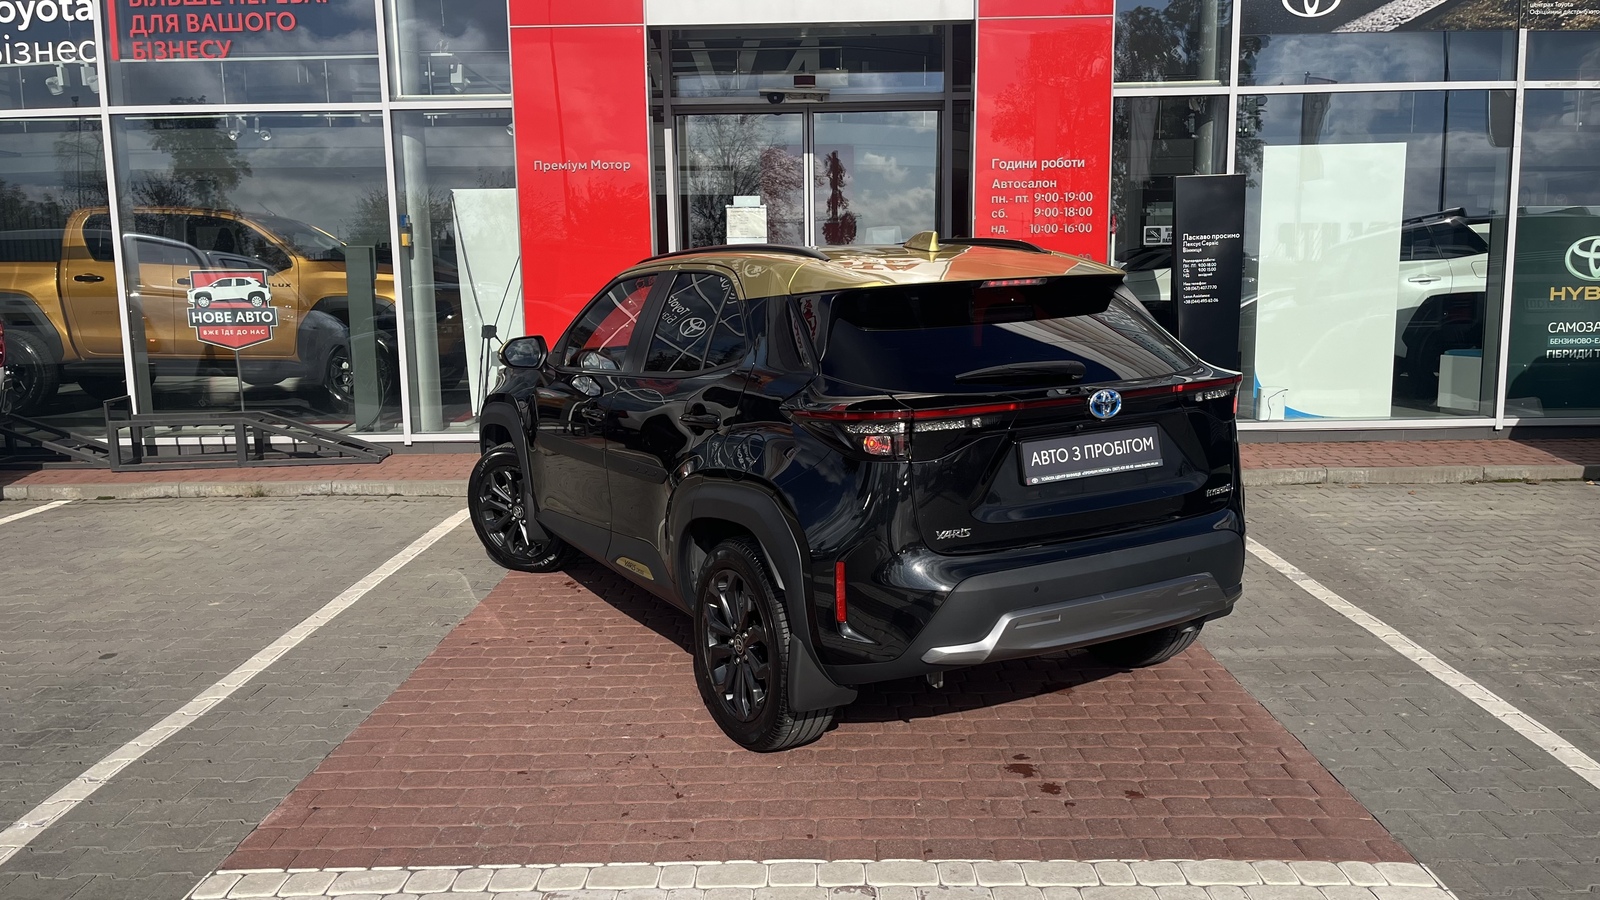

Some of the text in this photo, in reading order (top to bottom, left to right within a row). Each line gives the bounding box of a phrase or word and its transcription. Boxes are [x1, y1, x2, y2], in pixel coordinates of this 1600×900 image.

[130, 11, 296, 37] ДЛЯ ВАШОГО
[0, 34, 97, 64] ізнес
[132, 40, 232, 61] БІЗНЕСУ
[533, 160, 631, 173] Преміум Мотор
[991, 157, 1085, 171] Години роботи
[992, 179, 1057, 189] Автосалон
[1034, 192, 1093, 203] 9:00-19:00
[991, 207, 1093, 218] сб. 9:00-18:00
[991, 223, 1093, 235] нд. 10:00-16:00
[1183, 233, 1211, 241] Ласкаво
[192, 311, 273, 323] НОВЕ АВТО
[221, 328, 234, 336] ЇДЕ
[1546, 349, 1592, 359] ГІБРИДИ
[1031, 448, 1069, 467] АВТО
[1084, 436, 1154, 460] ПРОБІГОМ
[935, 527, 972, 541] YARIS
